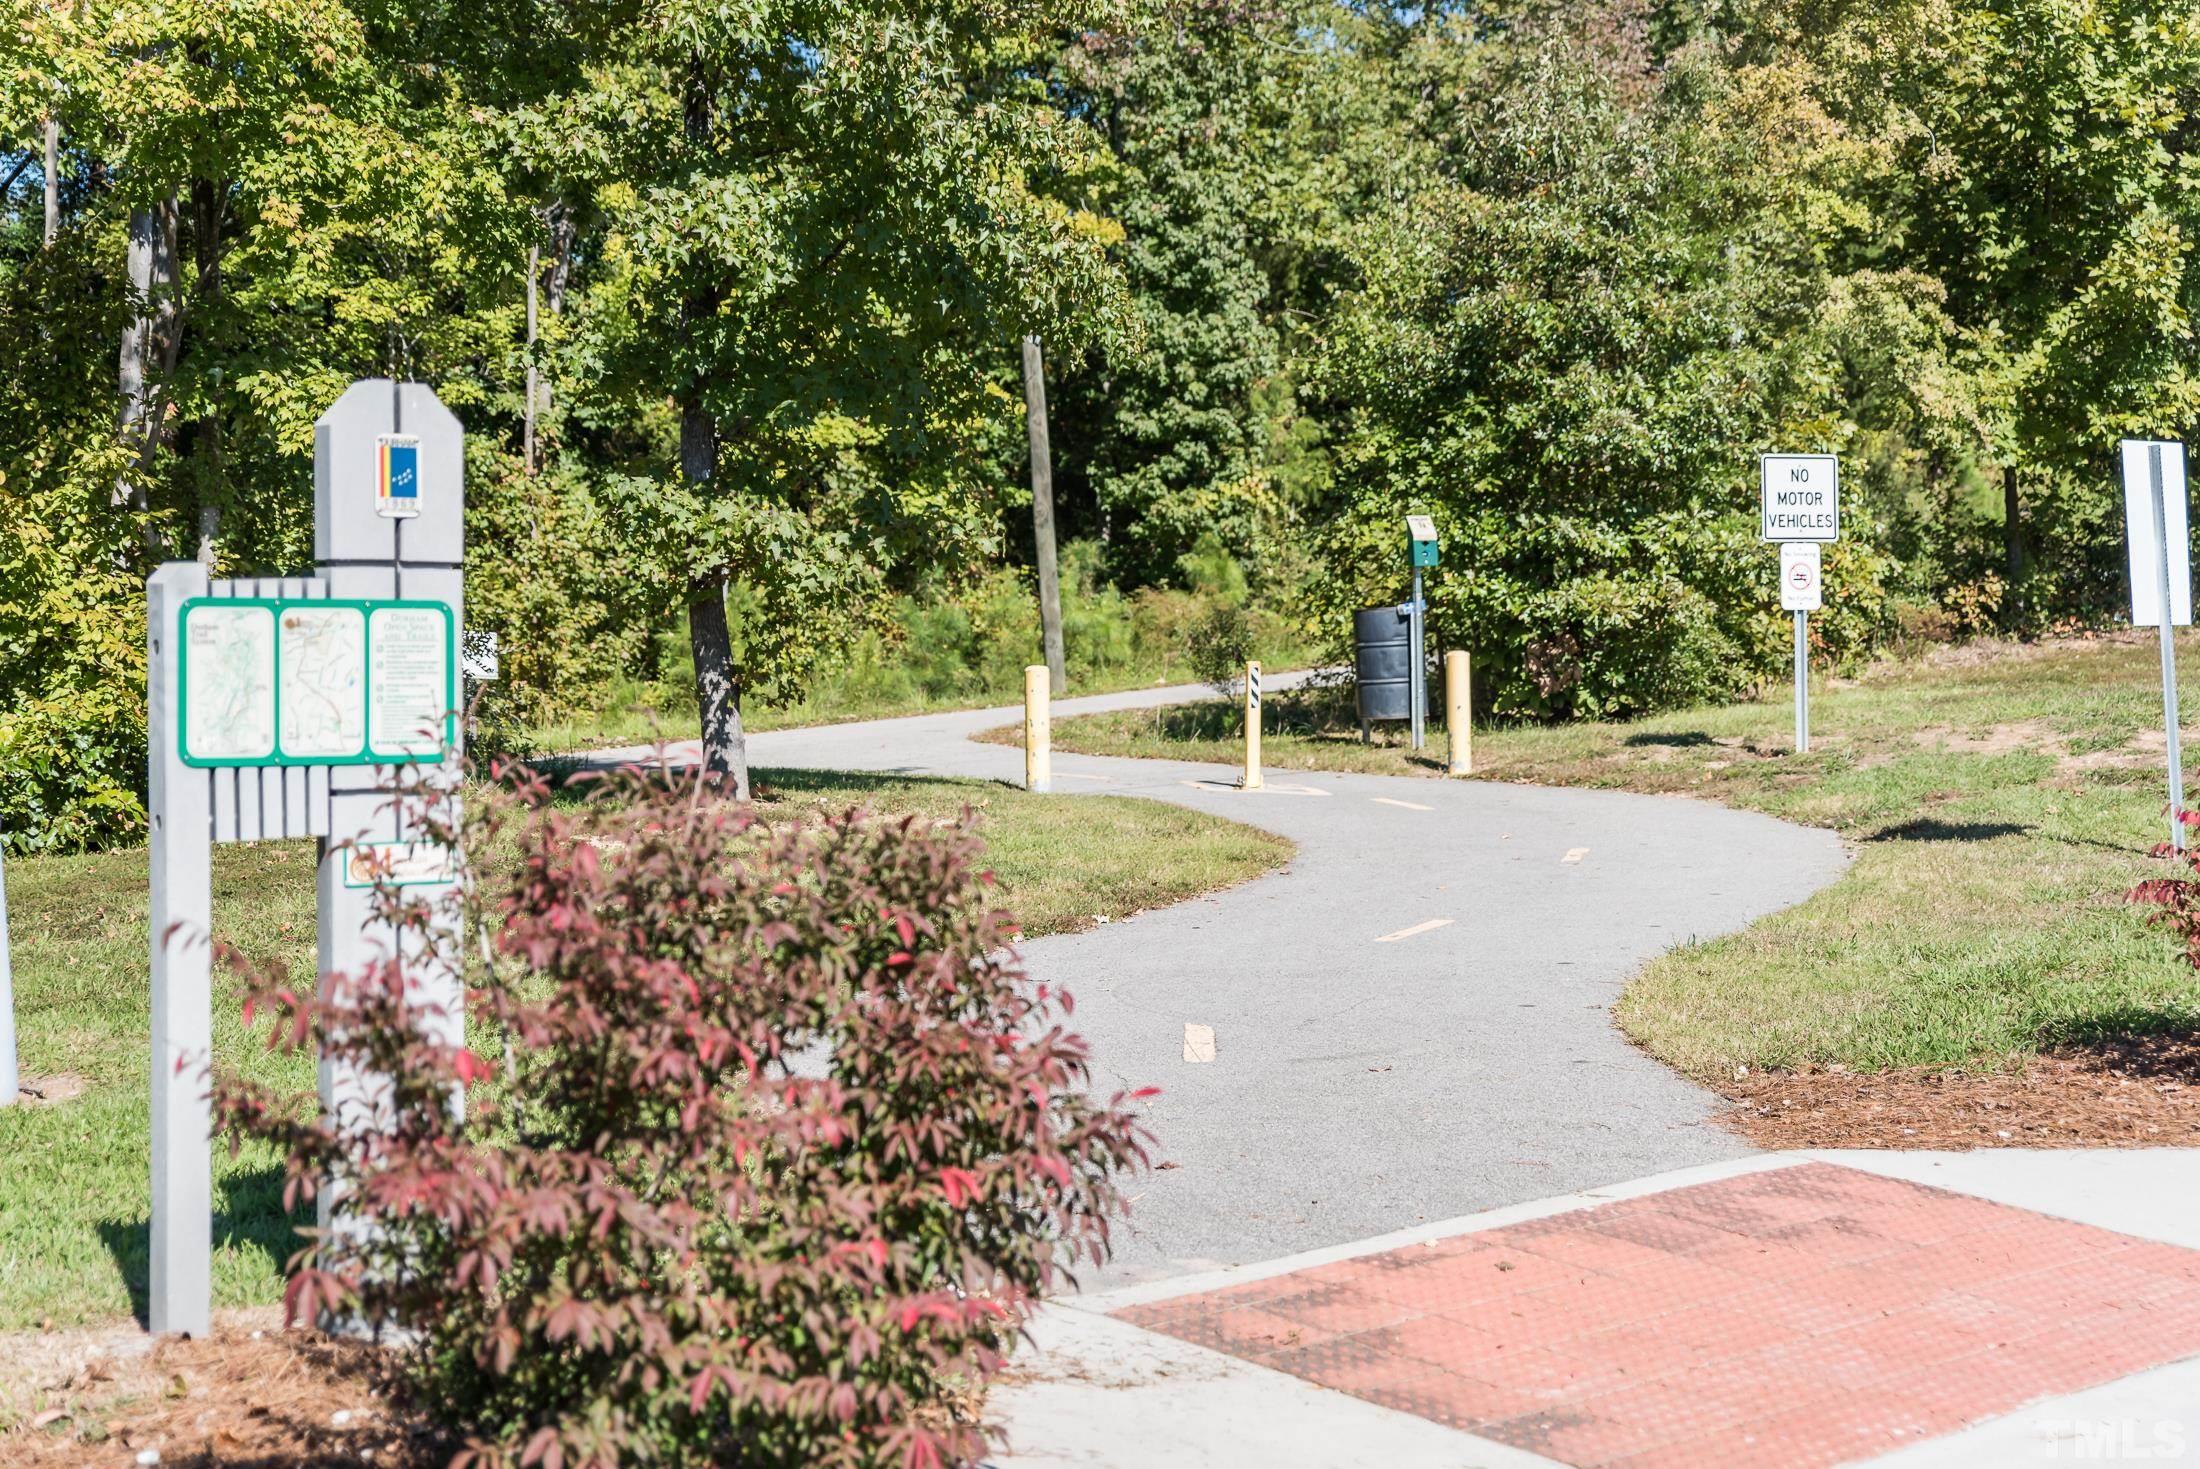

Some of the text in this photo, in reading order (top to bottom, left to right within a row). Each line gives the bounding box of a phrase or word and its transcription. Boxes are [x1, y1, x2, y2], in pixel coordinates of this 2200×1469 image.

[1791, 468, 1809, 482] NO
[1777, 492, 1823, 505] MOTOR
[1769, 514, 1833, 528] VEHICLES
